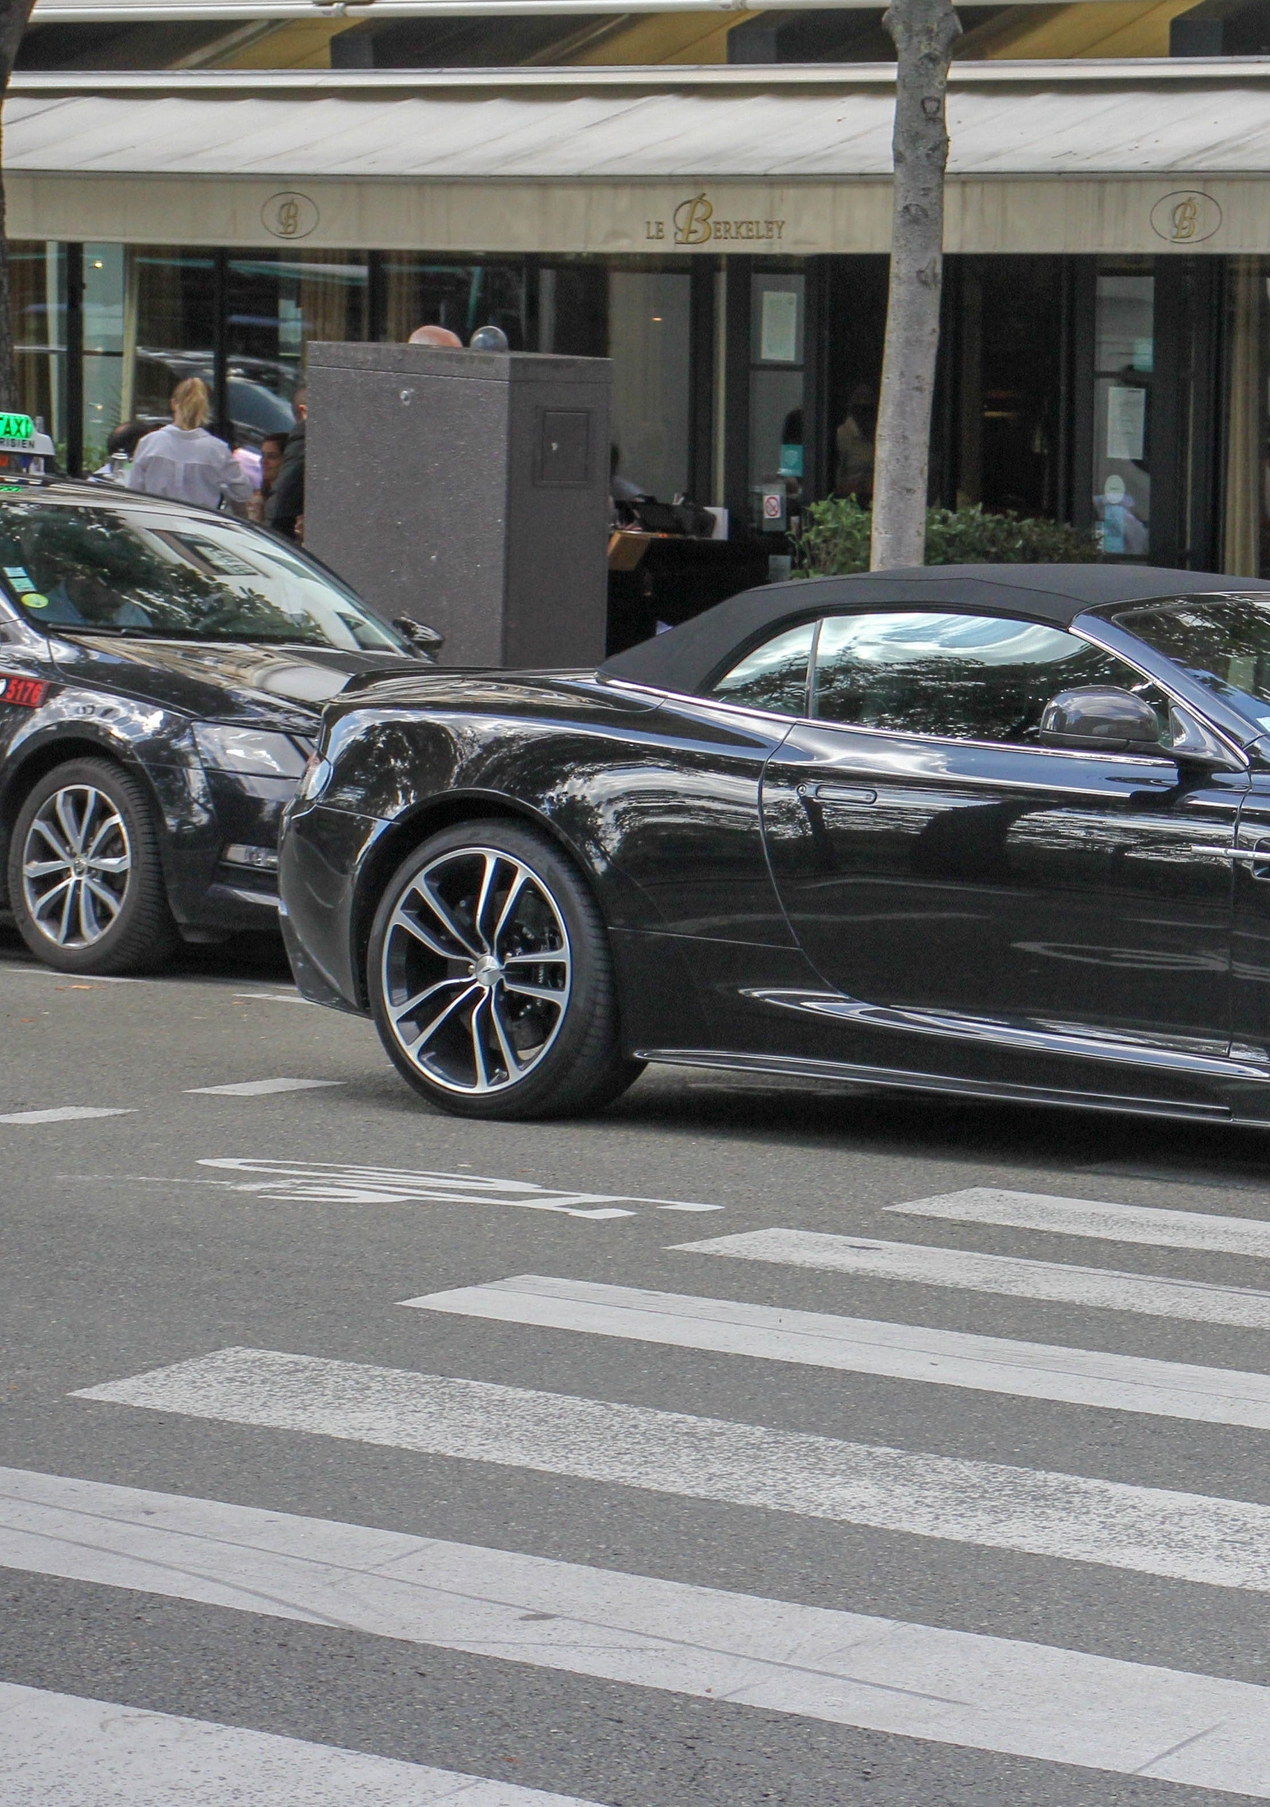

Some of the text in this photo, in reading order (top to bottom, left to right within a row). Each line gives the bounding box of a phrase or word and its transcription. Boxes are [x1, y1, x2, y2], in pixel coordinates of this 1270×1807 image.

[645, 192, 786, 245] LE BERKELEY
[6, 678, 43, 705] 5176
